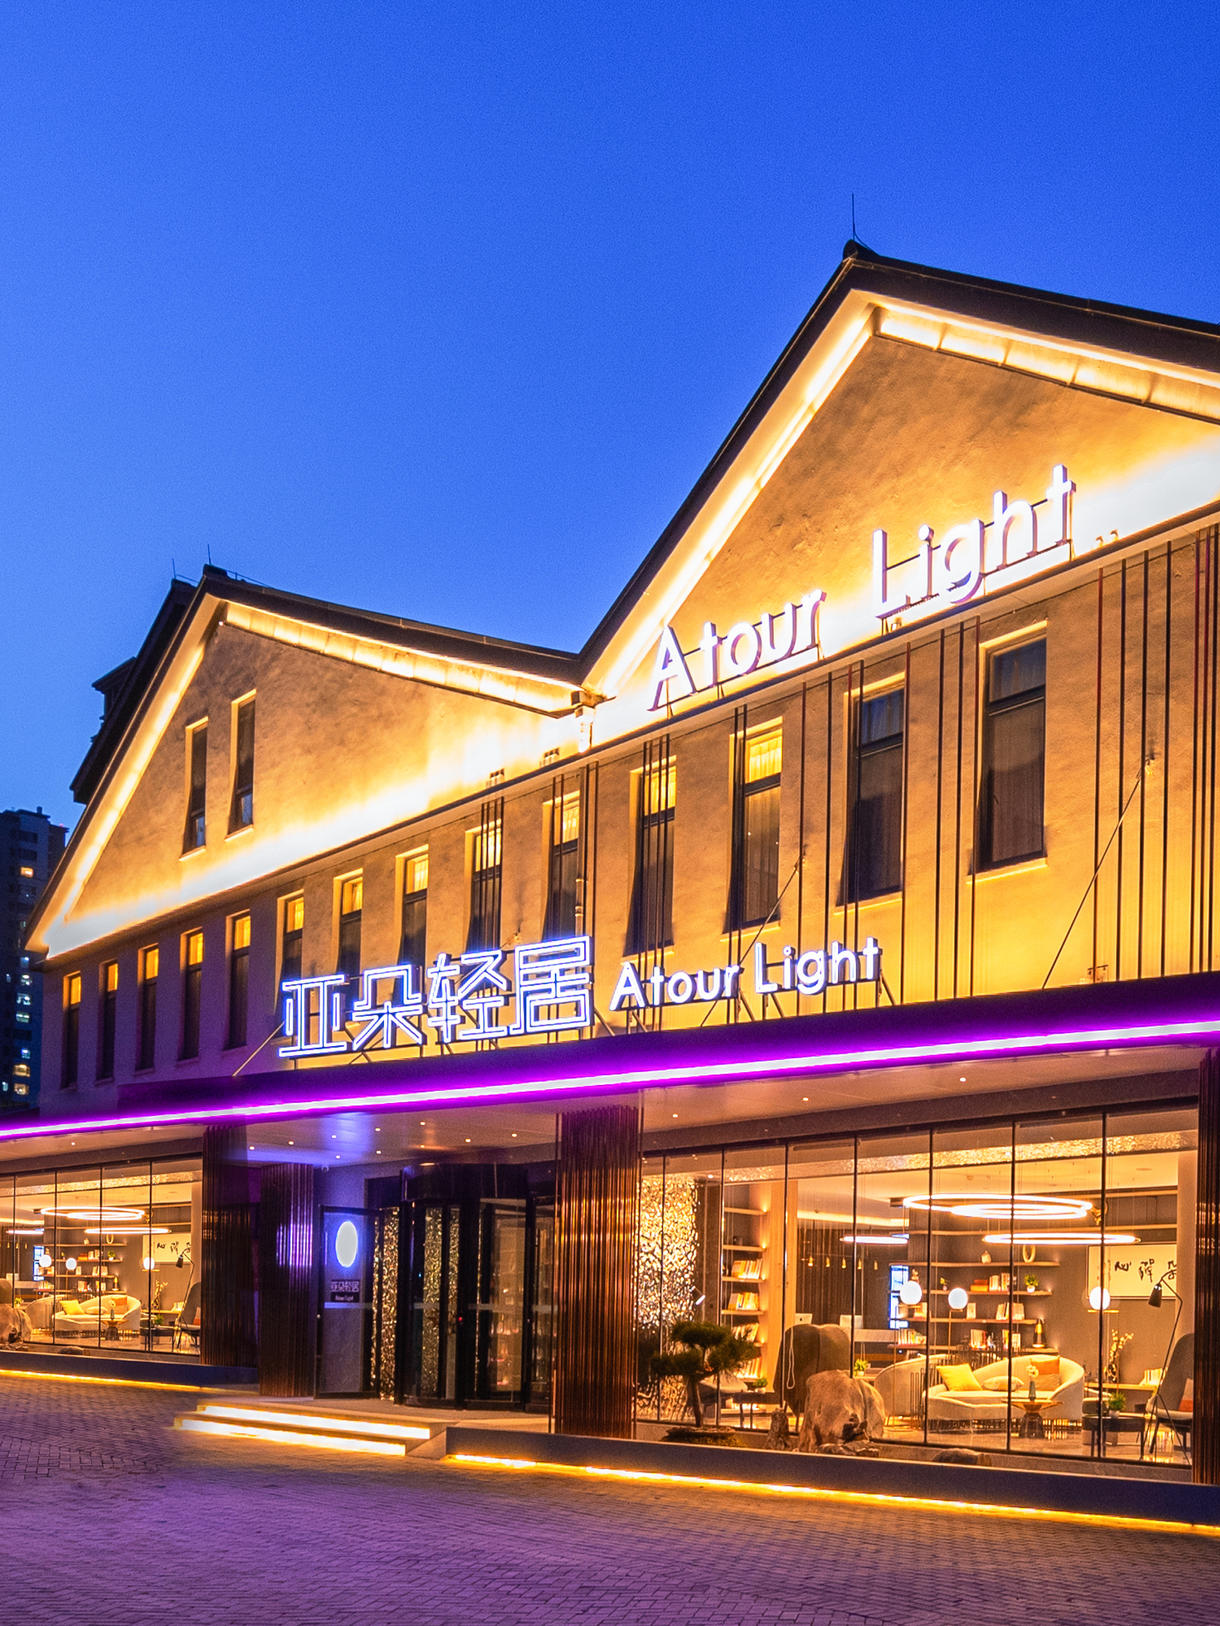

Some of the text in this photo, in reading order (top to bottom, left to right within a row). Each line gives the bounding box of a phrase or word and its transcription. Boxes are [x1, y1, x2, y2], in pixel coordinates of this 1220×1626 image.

[648, 464, 1077, 712] Atour Light
[278, 935, 593, 1058] 亚朵轻居
[609, 936, 882, 1012] Atour Light
